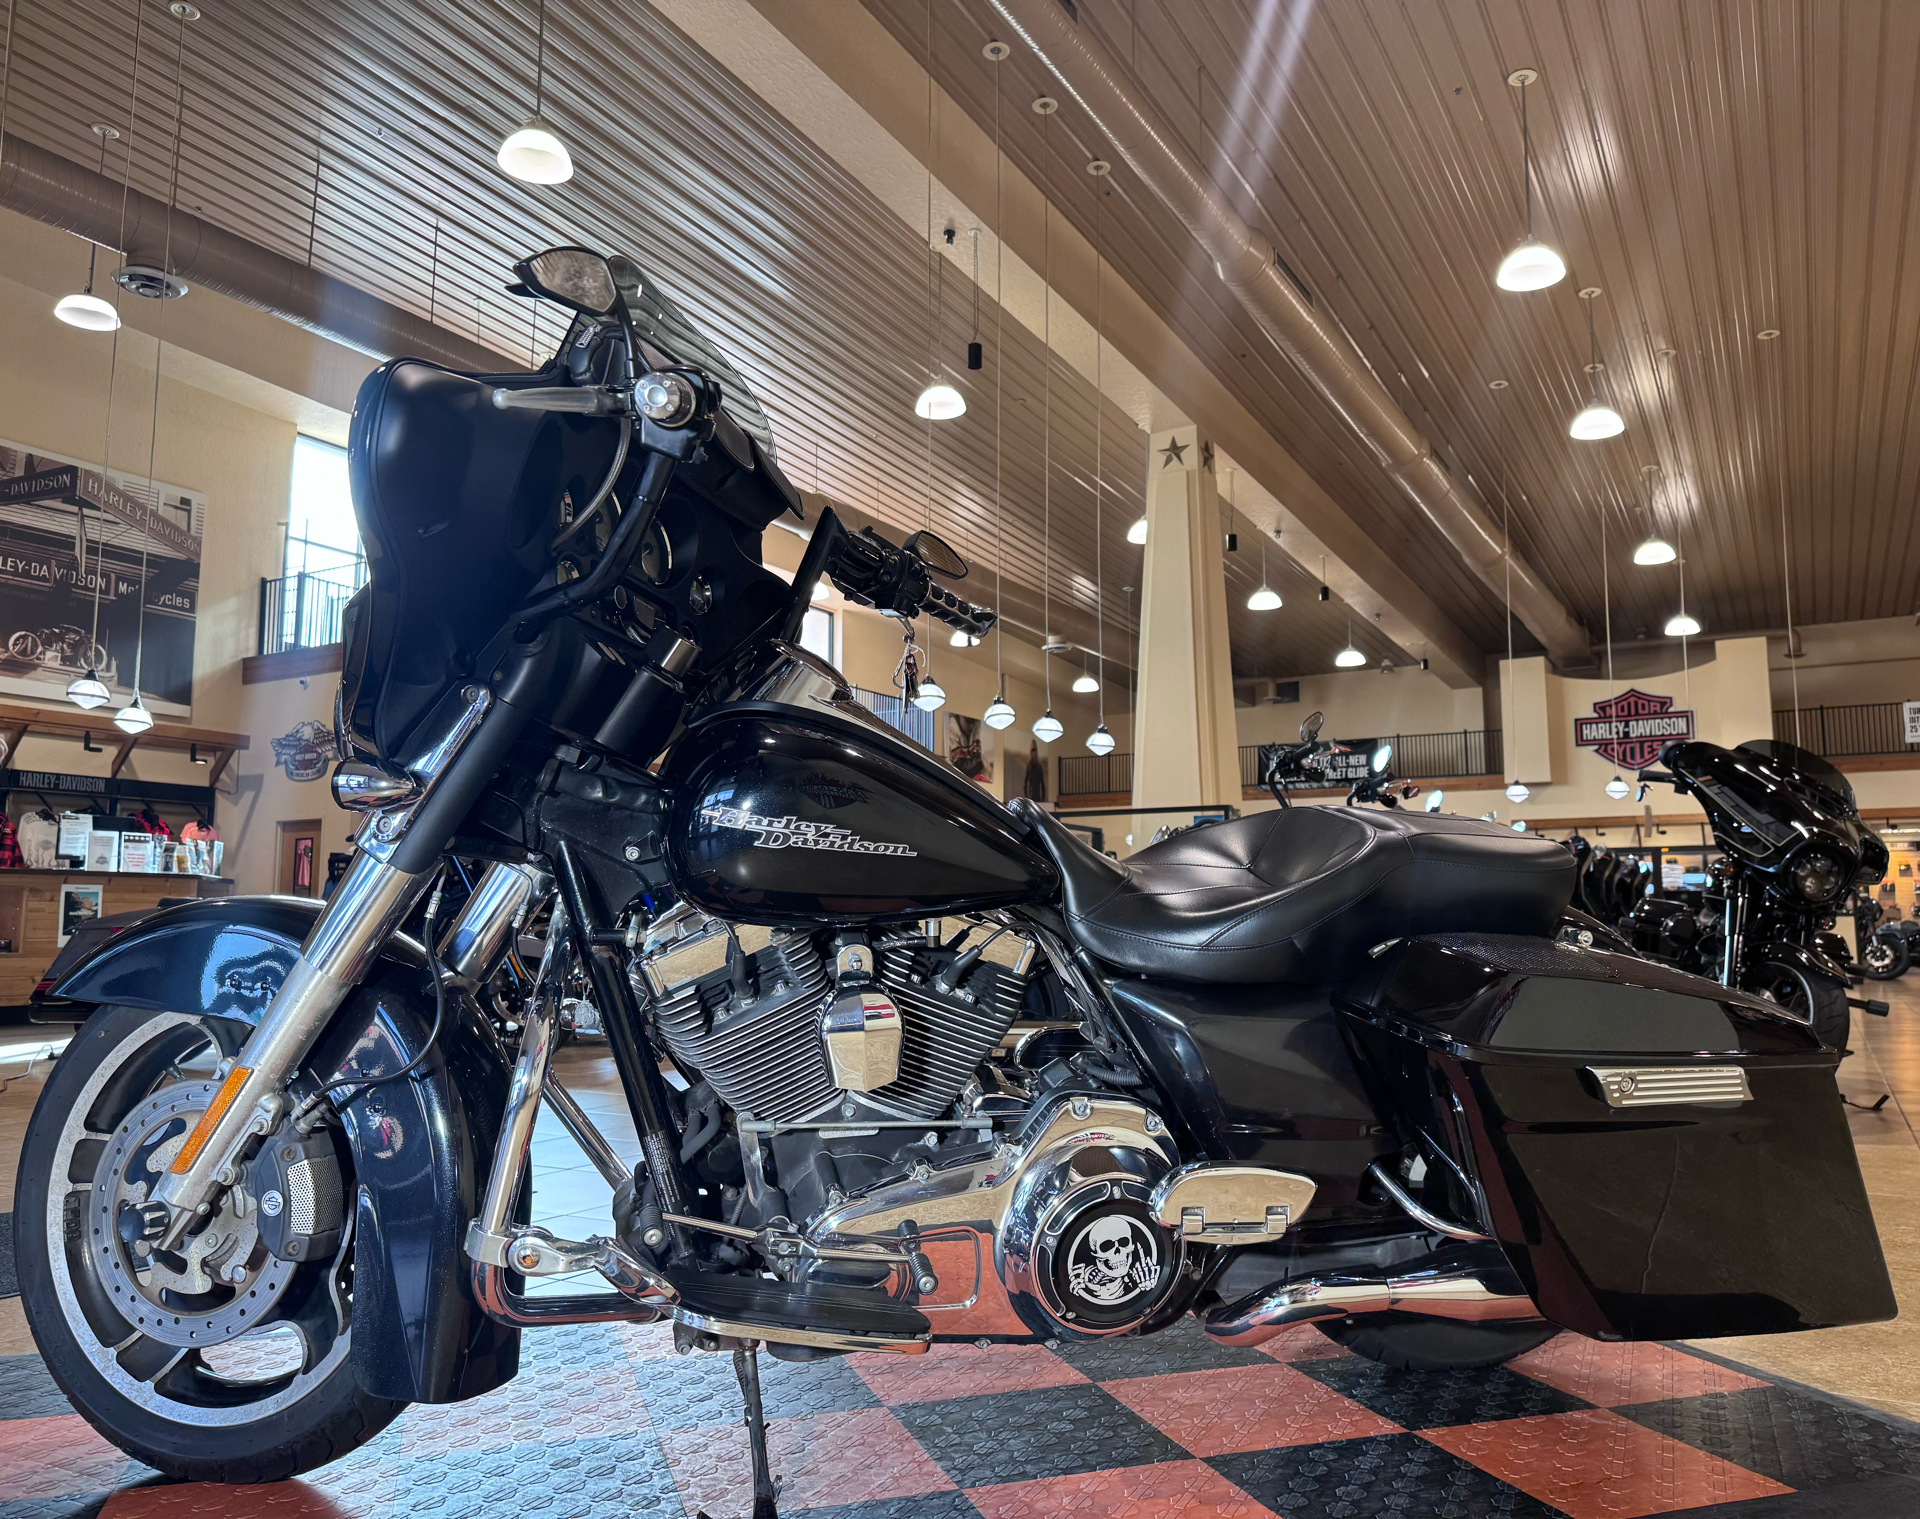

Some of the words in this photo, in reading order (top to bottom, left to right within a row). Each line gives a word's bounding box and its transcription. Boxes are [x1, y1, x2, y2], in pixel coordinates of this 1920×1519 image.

[0, 473, 71, 496] -DAVIDSON
[87, 478, 200, 555] HARLEY-DAVIDSON
[1605, 697, 1661, 718] MOTOR
[1582, 717, 1687, 741] HARLEY-DAVIDSON
[1607, 741, 1664, 765] CYCLES
[19, 771, 106, 793] HARLEY-DAVIDSON
[1347, 766, 1370, 779] GLIDE
[754, 829, 918, 857] Davidson
